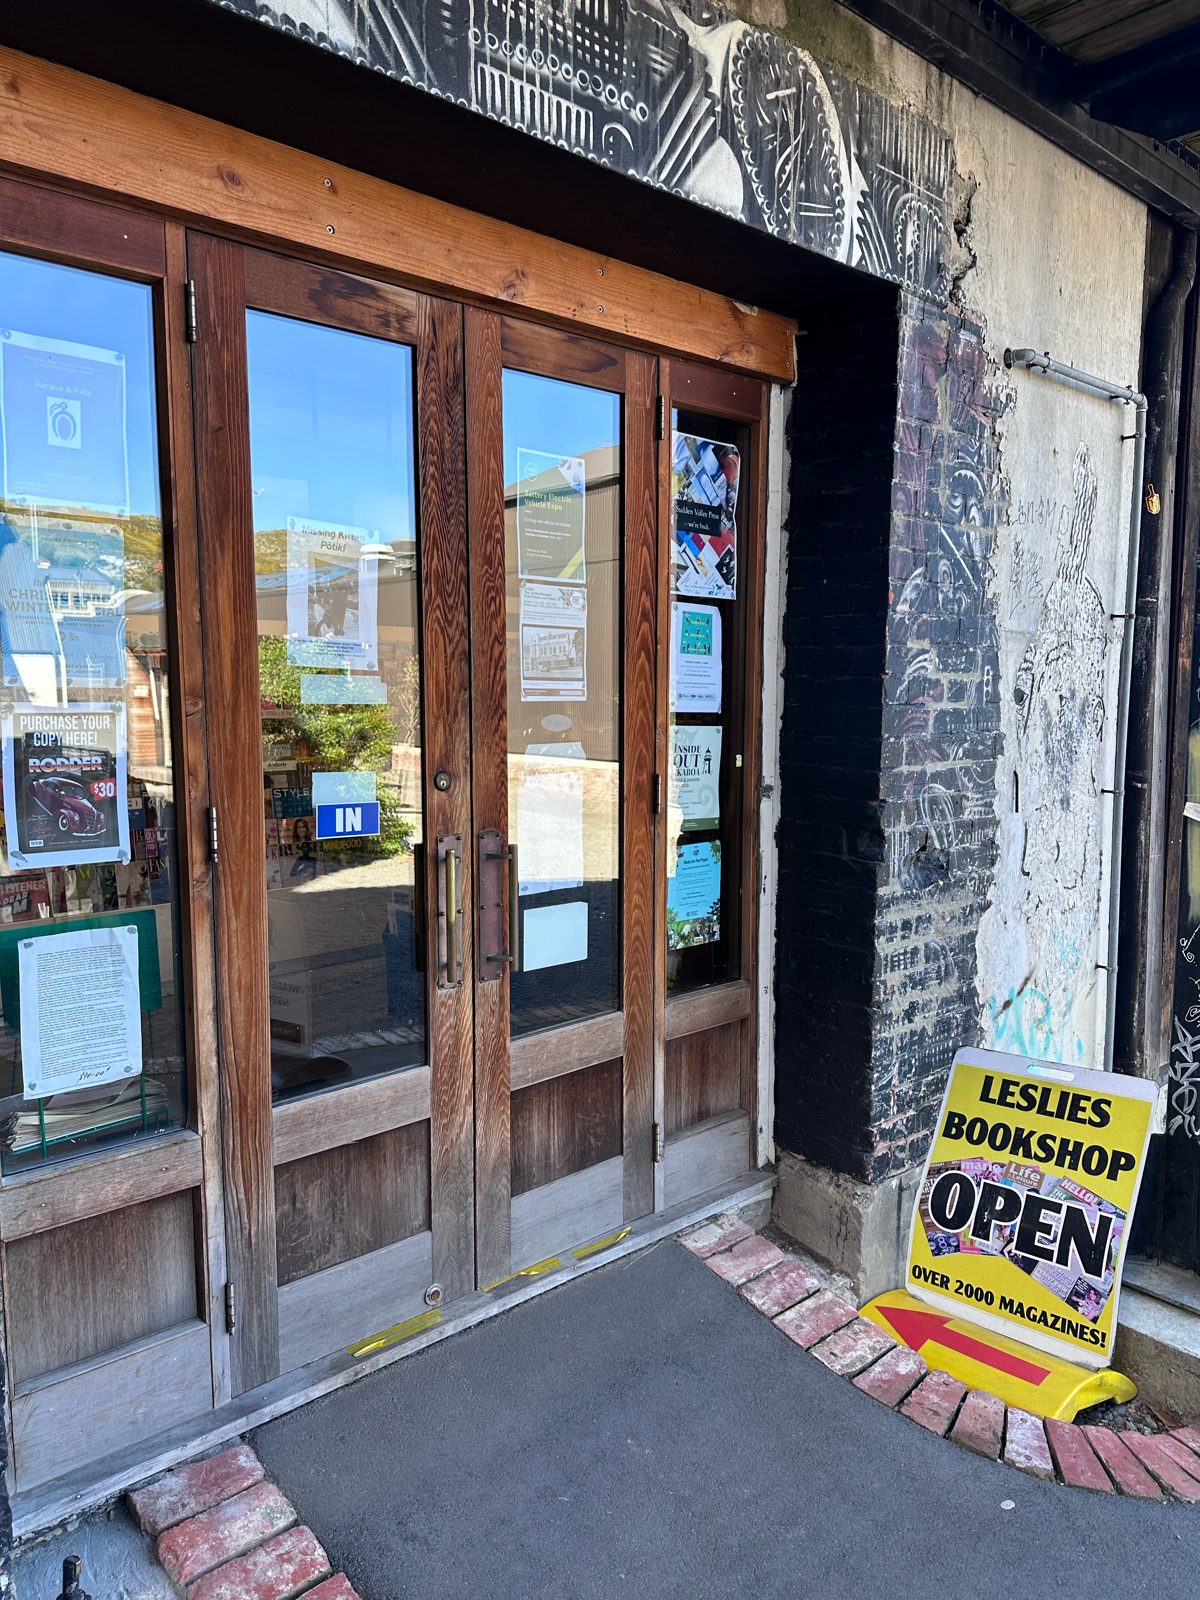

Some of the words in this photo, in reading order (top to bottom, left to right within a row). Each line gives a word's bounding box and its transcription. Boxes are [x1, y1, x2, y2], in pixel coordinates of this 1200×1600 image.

[524, 490, 547, 501] Battery
[548, 494, 572, 504] Electric
[547, 502, 563, 511] Expo
[675, 505, 694, 515] Sudden
[694, 508, 708, 518] Valley
[708, 511, 720, 520] Press
[302, 525, 336, 540] Missing
[338, 532, 365, 543] Kitten
[20, 715, 78, 730] PURCHASE
[81, 715, 110, 730] YOUR
[34, 731, 62, 747] COPY
[66, 731, 98, 746] HERE!
[674, 743, 701, 753] INSIDE
[28, 757, 103, 773] RODDER
[673, 754, 701, 768] OUT
[93, 782, 115, 798] $30
[273, 787, 310, 798] STYLE
[335, 807, 362, 833] IN
[323, 839, 362, 851] MINDFOOD
[0, 880, 45, 894] LISTENER
[979, 1074, 1112, 1128] LESLIES
[942, 1110, 1136, 1181] BOOKSHOP
[1009, 1163, 1041, 1181] Life
[1060, 1178, 1101, 1205] HELLO!
[929, 1171, 1114, 1278] OPEN
[911, 1264, 950, 1291] OVER
[954, 1280, 994, 1306] 2000
[999, 1296, 1107, 1348] MAGAZINES!
